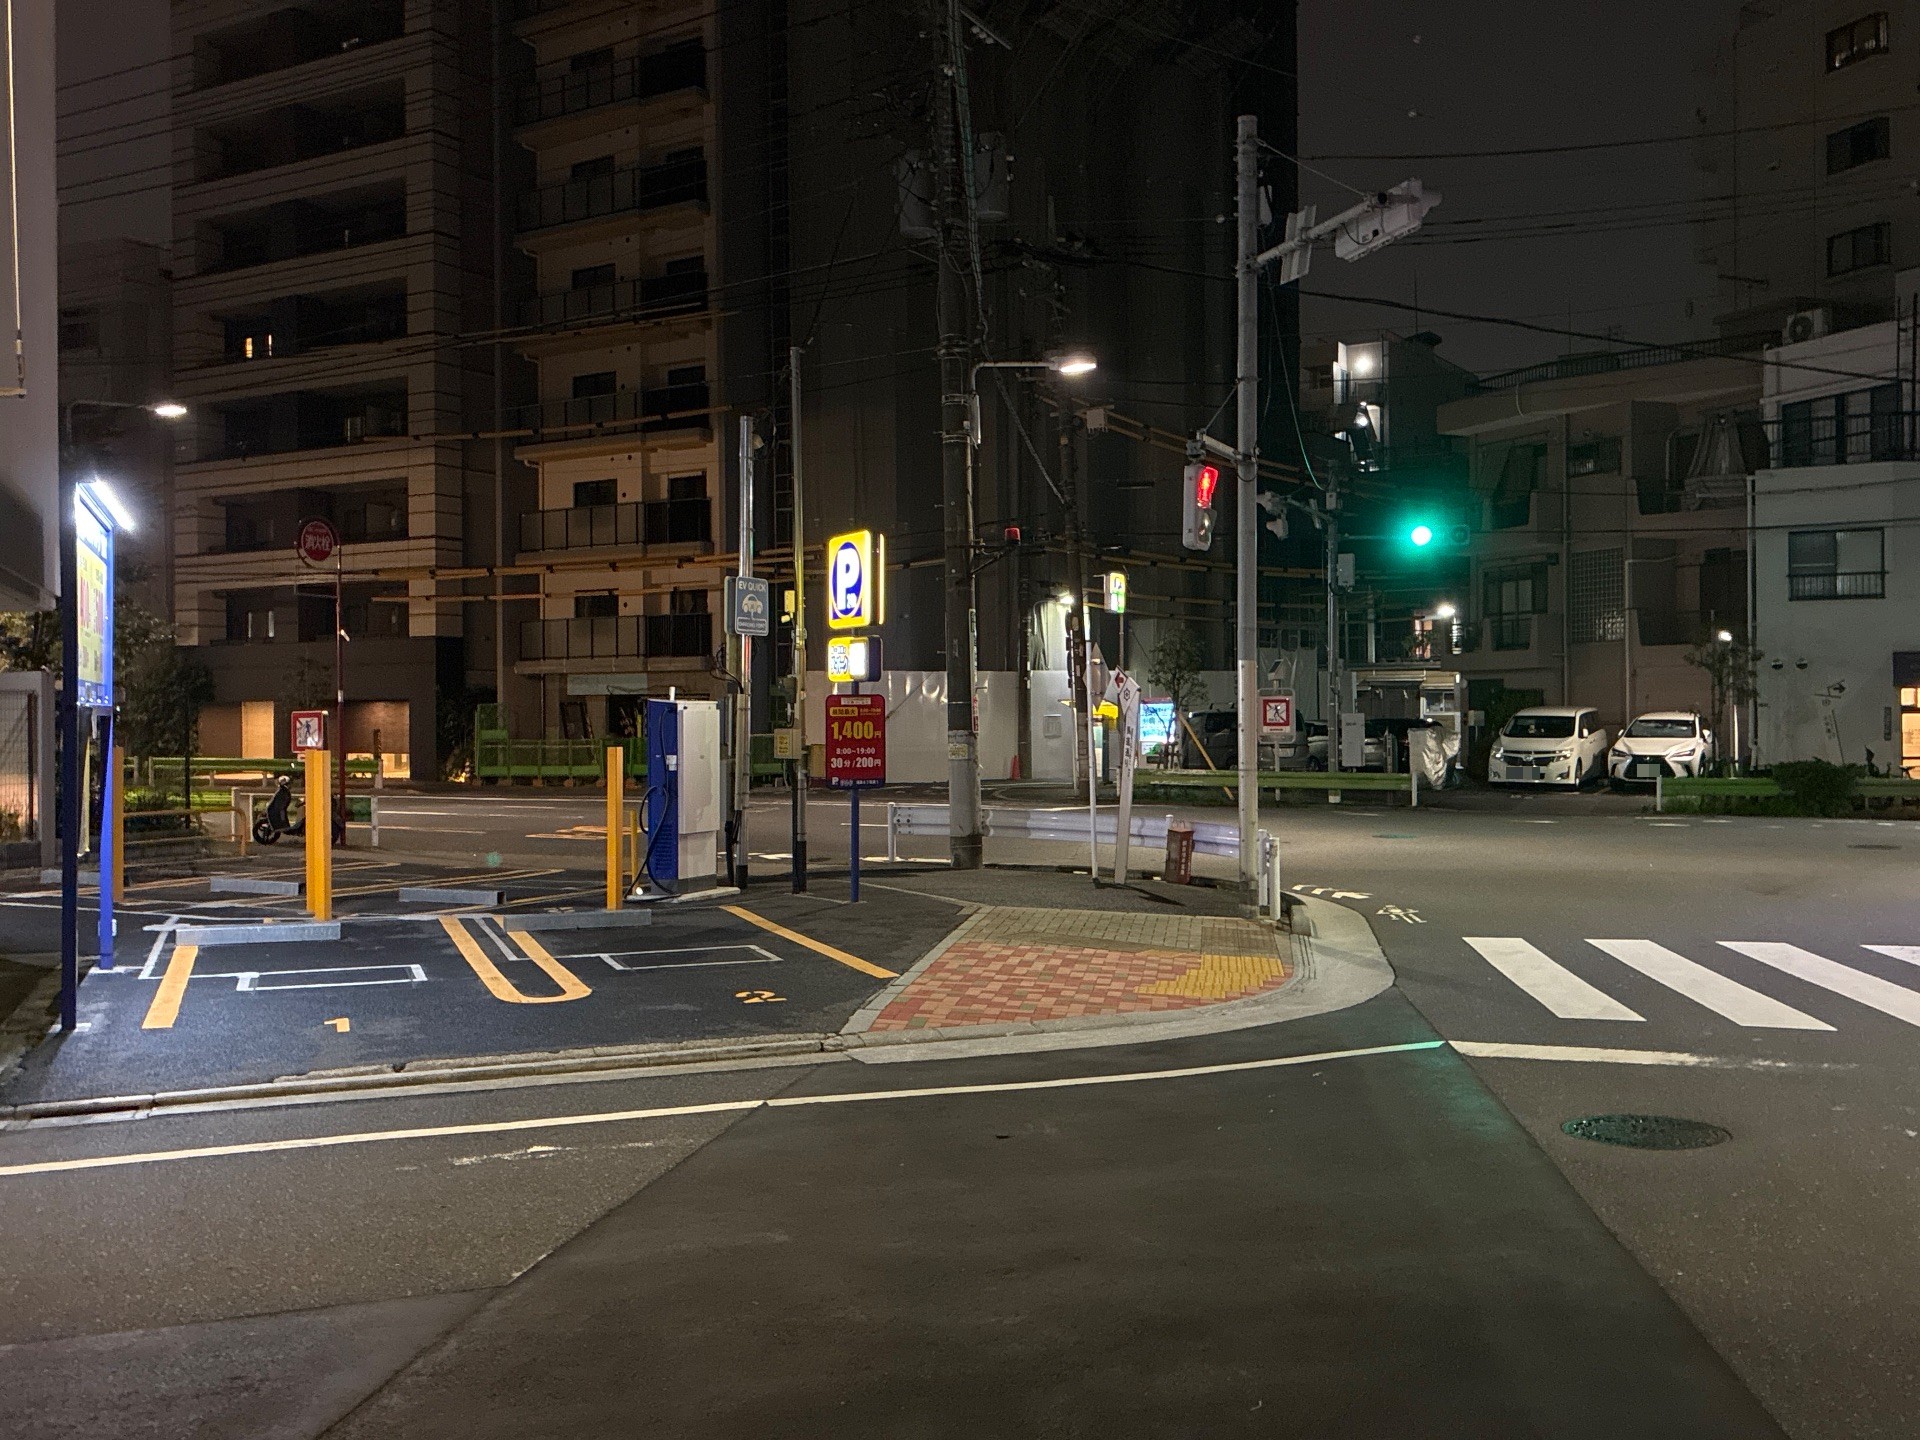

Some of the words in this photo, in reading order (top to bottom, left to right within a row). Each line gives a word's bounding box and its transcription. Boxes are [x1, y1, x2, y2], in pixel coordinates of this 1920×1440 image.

[305, 534, 331, 551] 消火栓
[738, 581, 748, 590] EV
[748, 582, 766, 592] QUICK
[735, 990, 787, 1004] 2
[323, 1017, 351, 1033] 1
